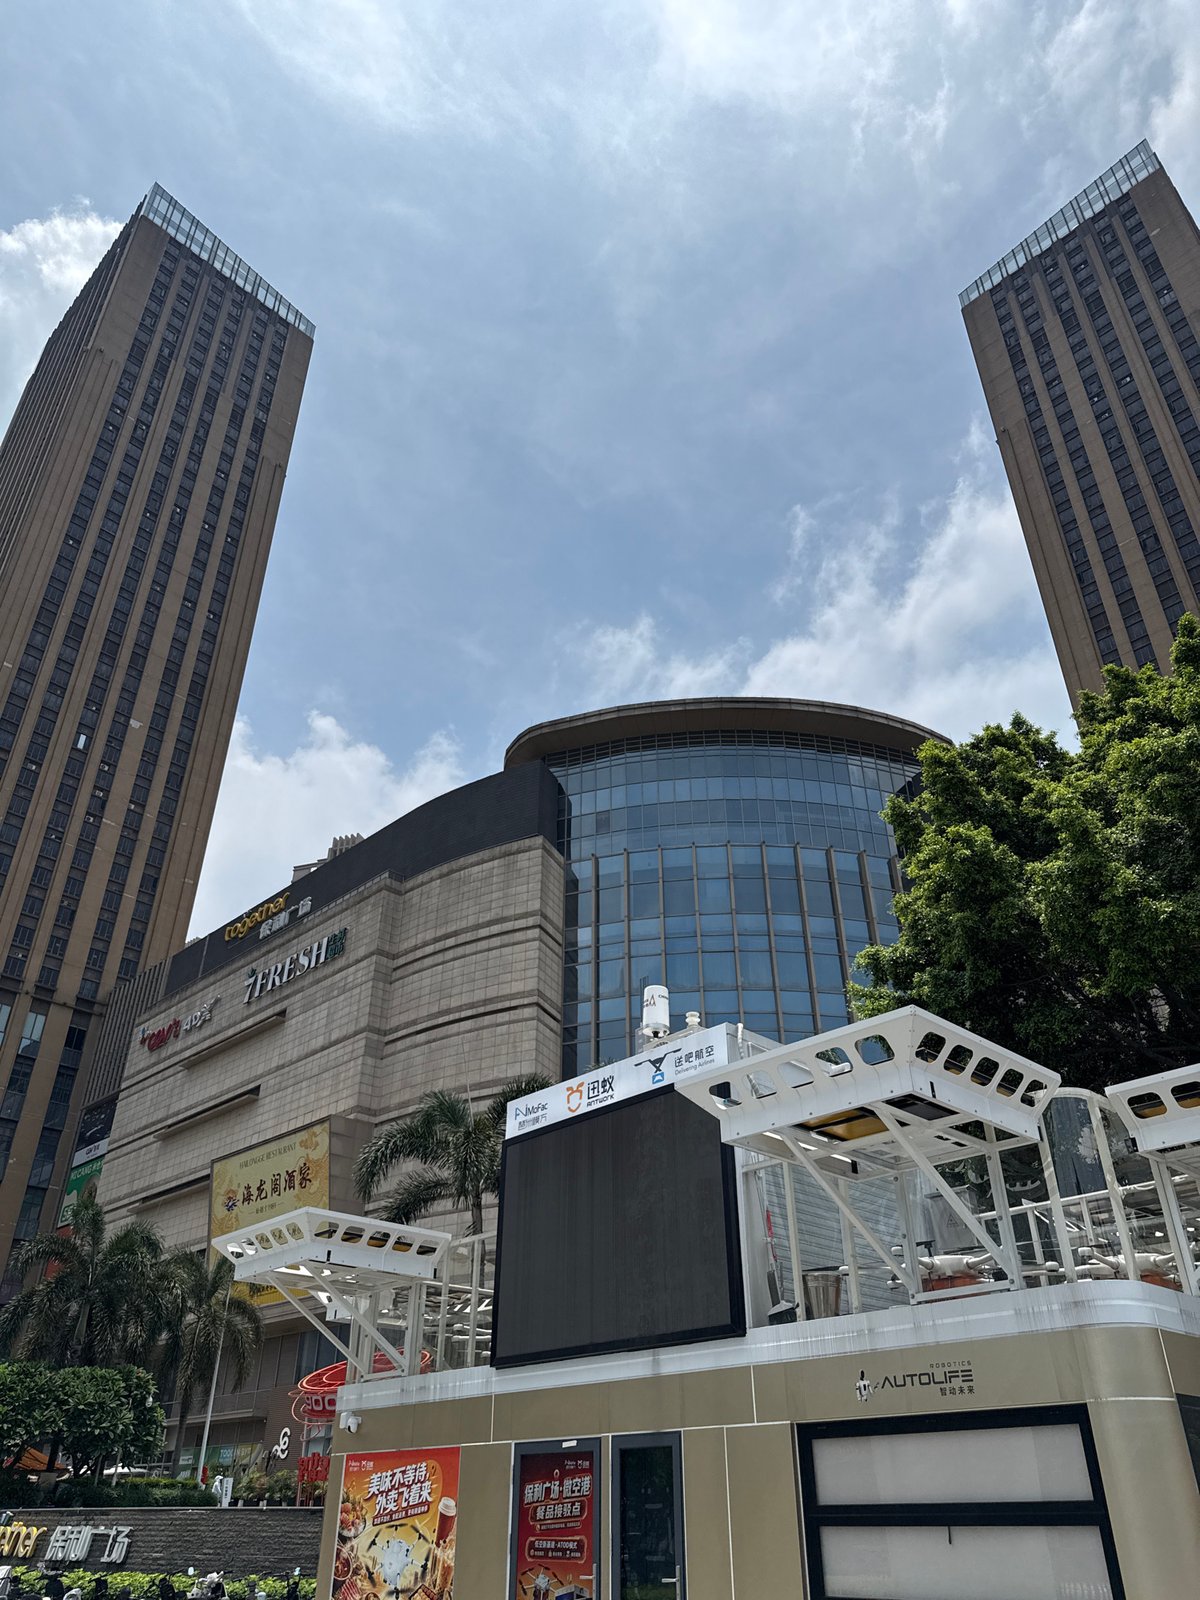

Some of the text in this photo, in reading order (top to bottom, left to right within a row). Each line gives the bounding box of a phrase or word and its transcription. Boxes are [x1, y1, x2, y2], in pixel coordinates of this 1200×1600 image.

[224, 892, 290, 941] together
[243, 936, 328, 1004] 7FRESH
[674, 1045, 715, 1069] 送吧航空
[674, 1058, 715, 1076] Delivering Airlines
[587, 1075, 614, 1099] 迅蚁
[265, 1142, 297, 1160] RESTAURANT
[241, 1162, 312, 1206] 海龙阁酒家
[929, 1360, 972, 1369] ROBOTICS
[881, 1369, 974, 1389] AUTOLIFE
[940, 1385, 975, 1397] 智动未来
[371, 1480, 433, 1518] 外卖飞着来
[536, 1502, 581, 1520] 餐品接驳点
[44, 1525, 134, 1564] 保利广场
